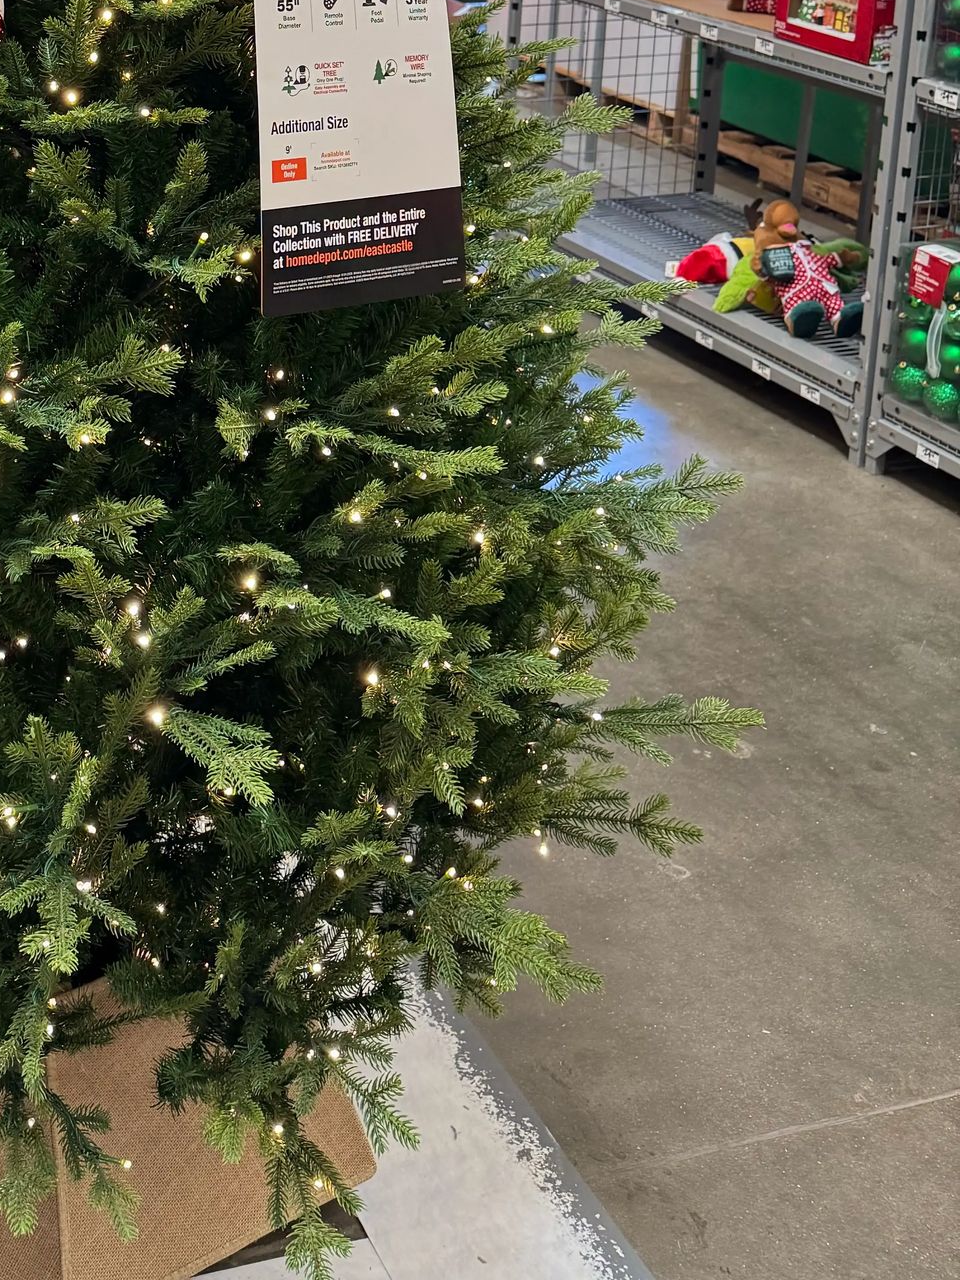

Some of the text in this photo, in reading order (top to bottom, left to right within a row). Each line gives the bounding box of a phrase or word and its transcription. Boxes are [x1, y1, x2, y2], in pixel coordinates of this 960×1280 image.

[408, 14, 428, 22] Warranty
[278, 22, 301, 30] Diameter
[405, 54, 429, 63] MEMORY
[314, 62, 331, 70] QUICK
[271, 116, 349, 135] Additional Size
[283, 170, 296, 178] Only
[273, 208, 426, 239] Shop This Product and the Entire
[273, 236, 322, 254] Collection
[324, 233, 345, 247] with
[347, 229, 371, 244] FREE
[273, 239, 413, 269] at homedepot.com/eastcastle
